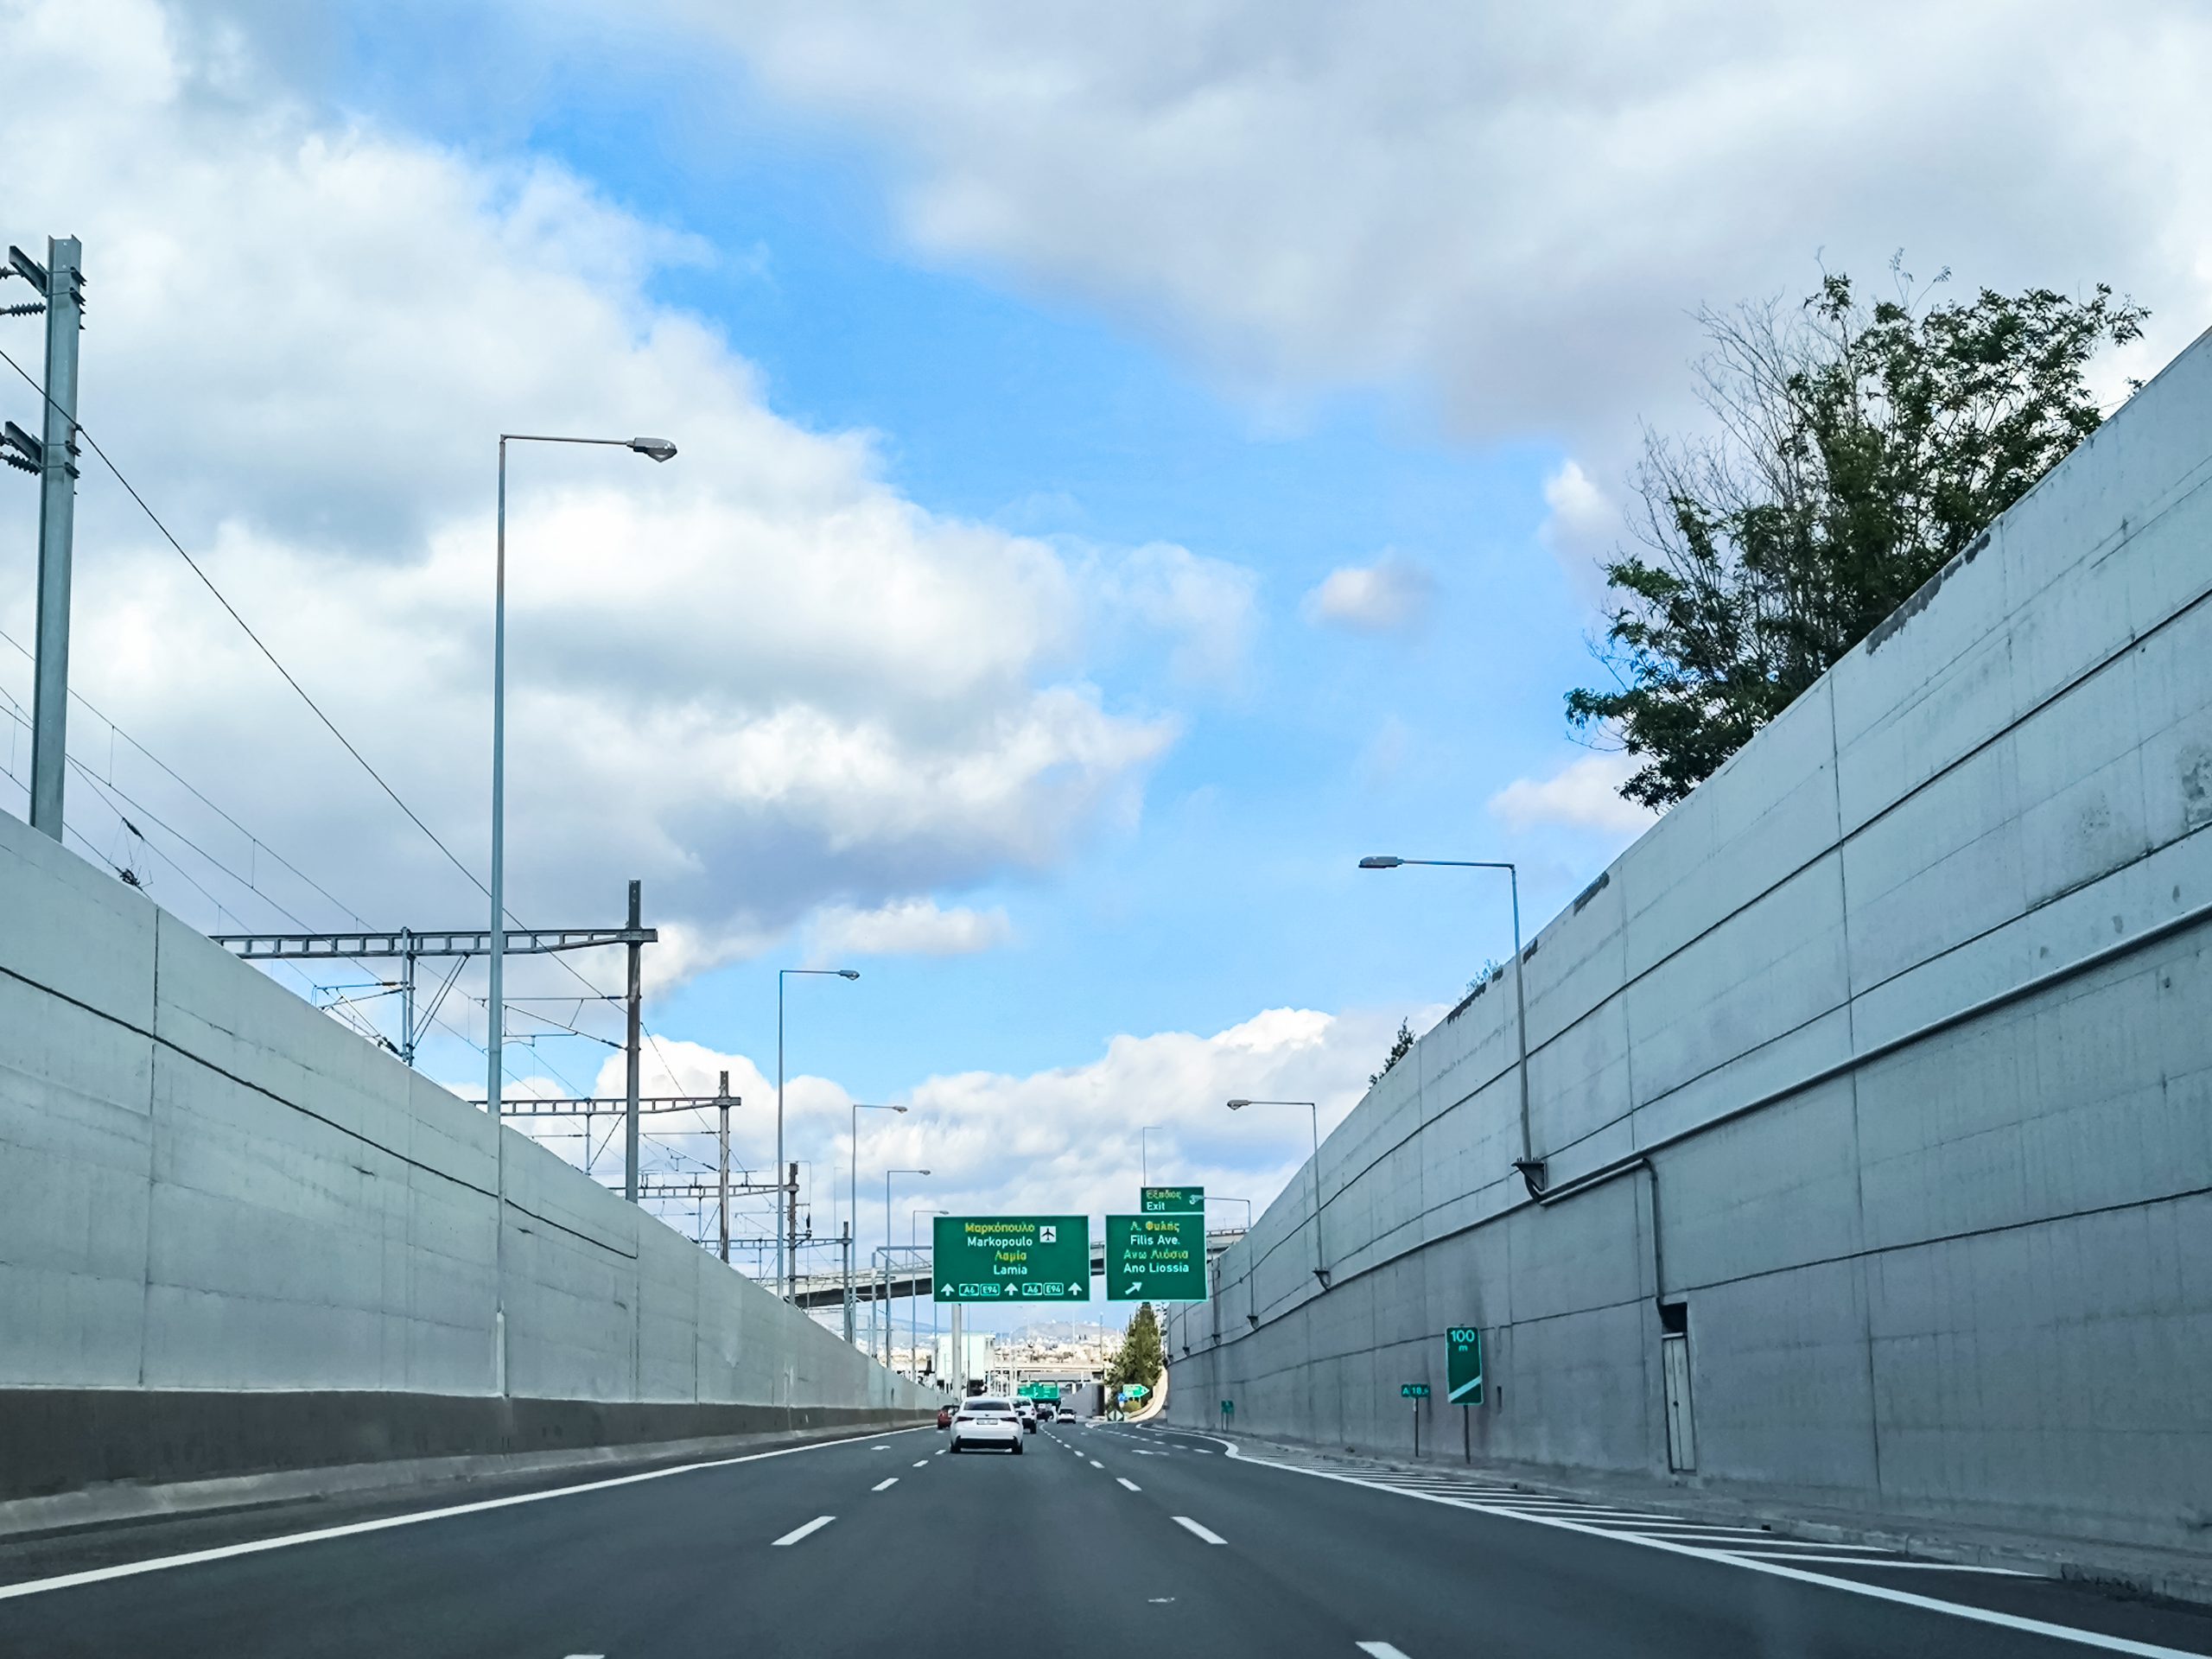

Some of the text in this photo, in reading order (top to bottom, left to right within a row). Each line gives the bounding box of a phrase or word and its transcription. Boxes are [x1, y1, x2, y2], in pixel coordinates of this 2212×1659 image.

[1147, 1201, 1166, 1211] Exit
[964, 1221, 1035, 1235] Μαρκόπουλο
[967, 1236, 1033, 1249] Markopoulo
[1130, 1235, 1180, 1245] Filis Ave.
[995, 1249, 1027, 1262] Λαμία
[993, 1264, 1028, 1275] Lamia
[1123, 1262, 1190, 1274] Ano Liossia
[1450, 1329, 1476, 1343] 100
[1459, 1344, 1468, 1352] m
